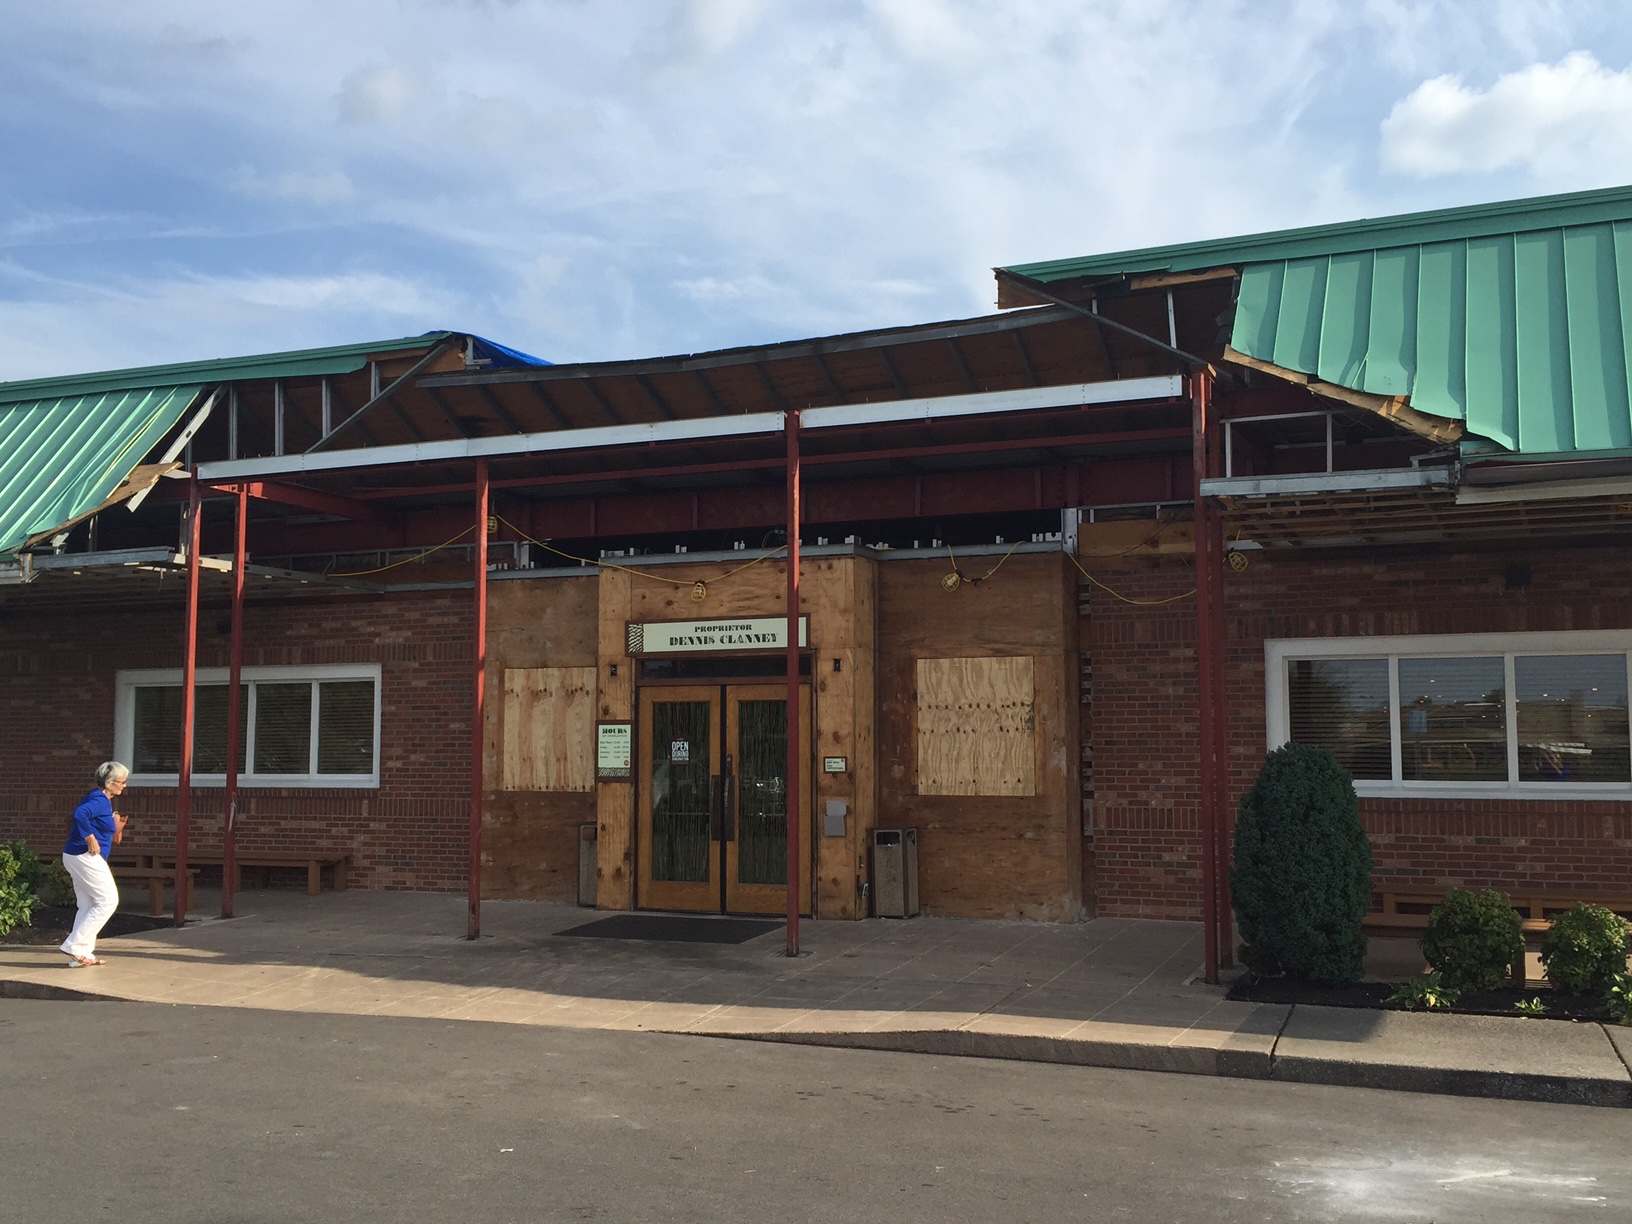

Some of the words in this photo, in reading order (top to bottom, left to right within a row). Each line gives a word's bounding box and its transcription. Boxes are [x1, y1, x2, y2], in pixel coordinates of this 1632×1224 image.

[694, 624, 752, 633] PROPRIETOR
[669, 636, 715, 646] DENNIS
[719, 633, 778, 644] CLANNEY
[671, 741, 689, 751] OPEN
